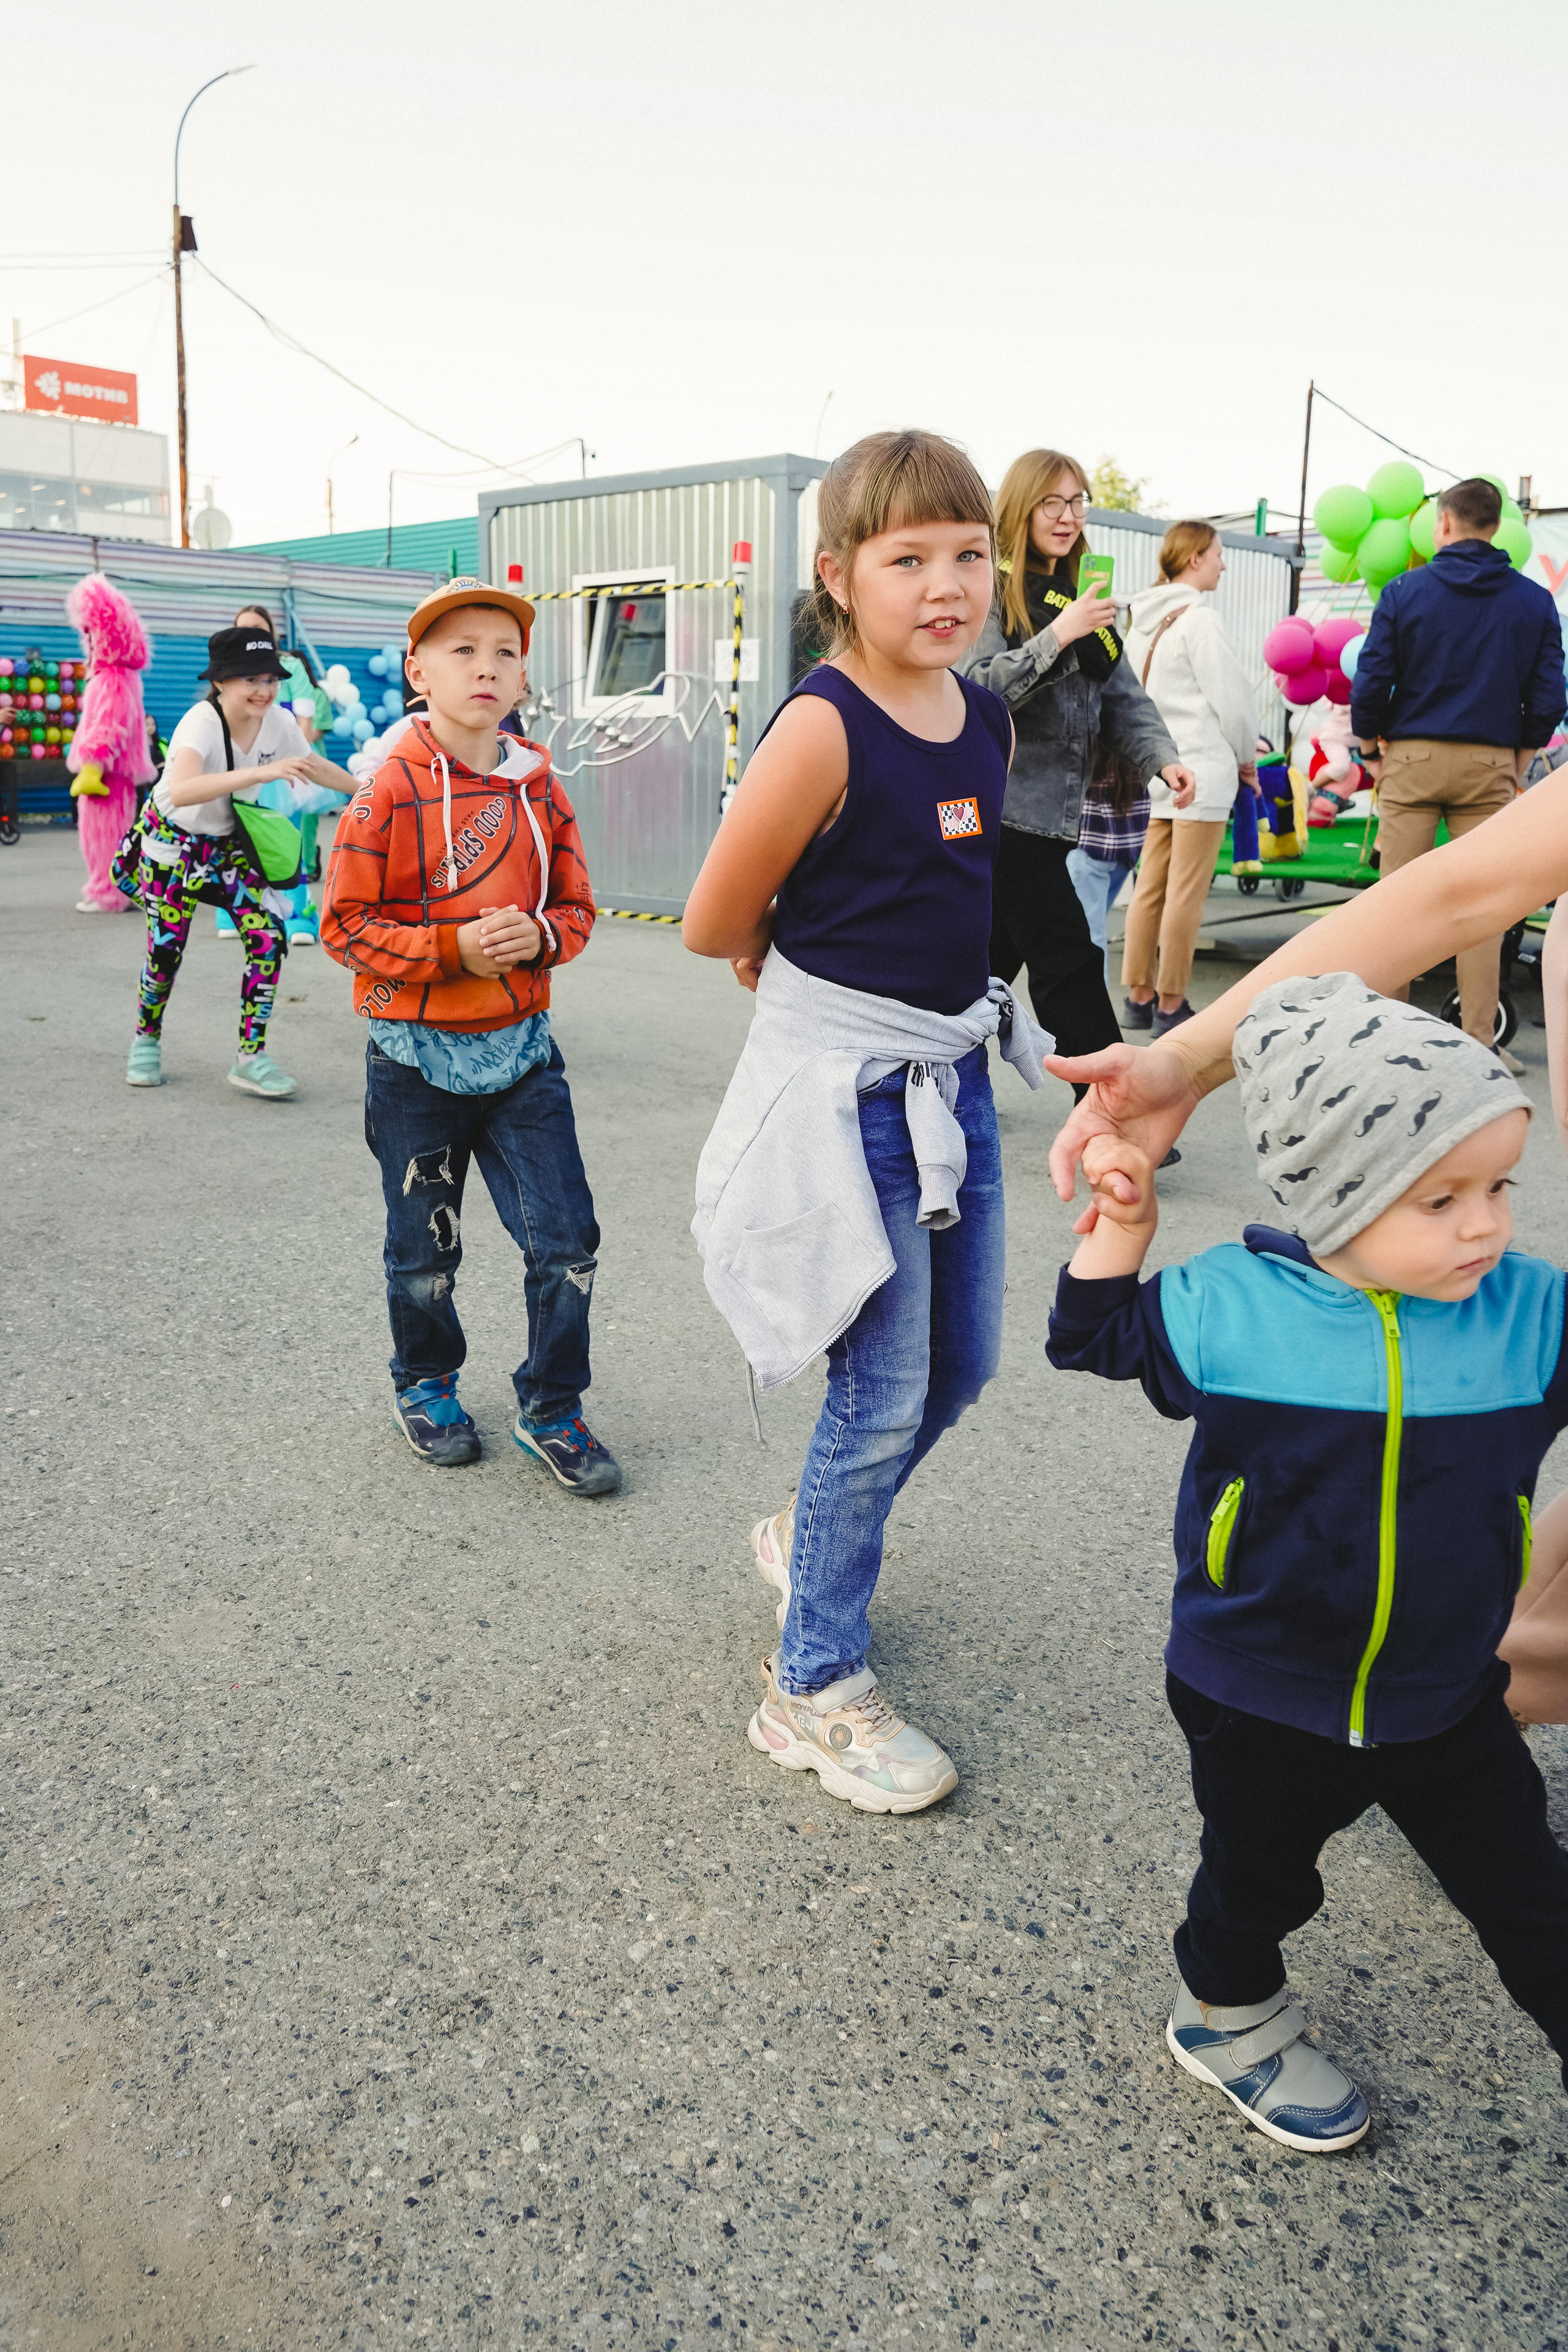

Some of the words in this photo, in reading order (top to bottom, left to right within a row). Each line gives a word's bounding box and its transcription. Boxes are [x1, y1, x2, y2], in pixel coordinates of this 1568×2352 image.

[246, 641, 257, 651] NO
[461, 810, 474, 825] PASS
[473, 797, 507, 839] GOOD
[451, 826, 462, 838] THE
